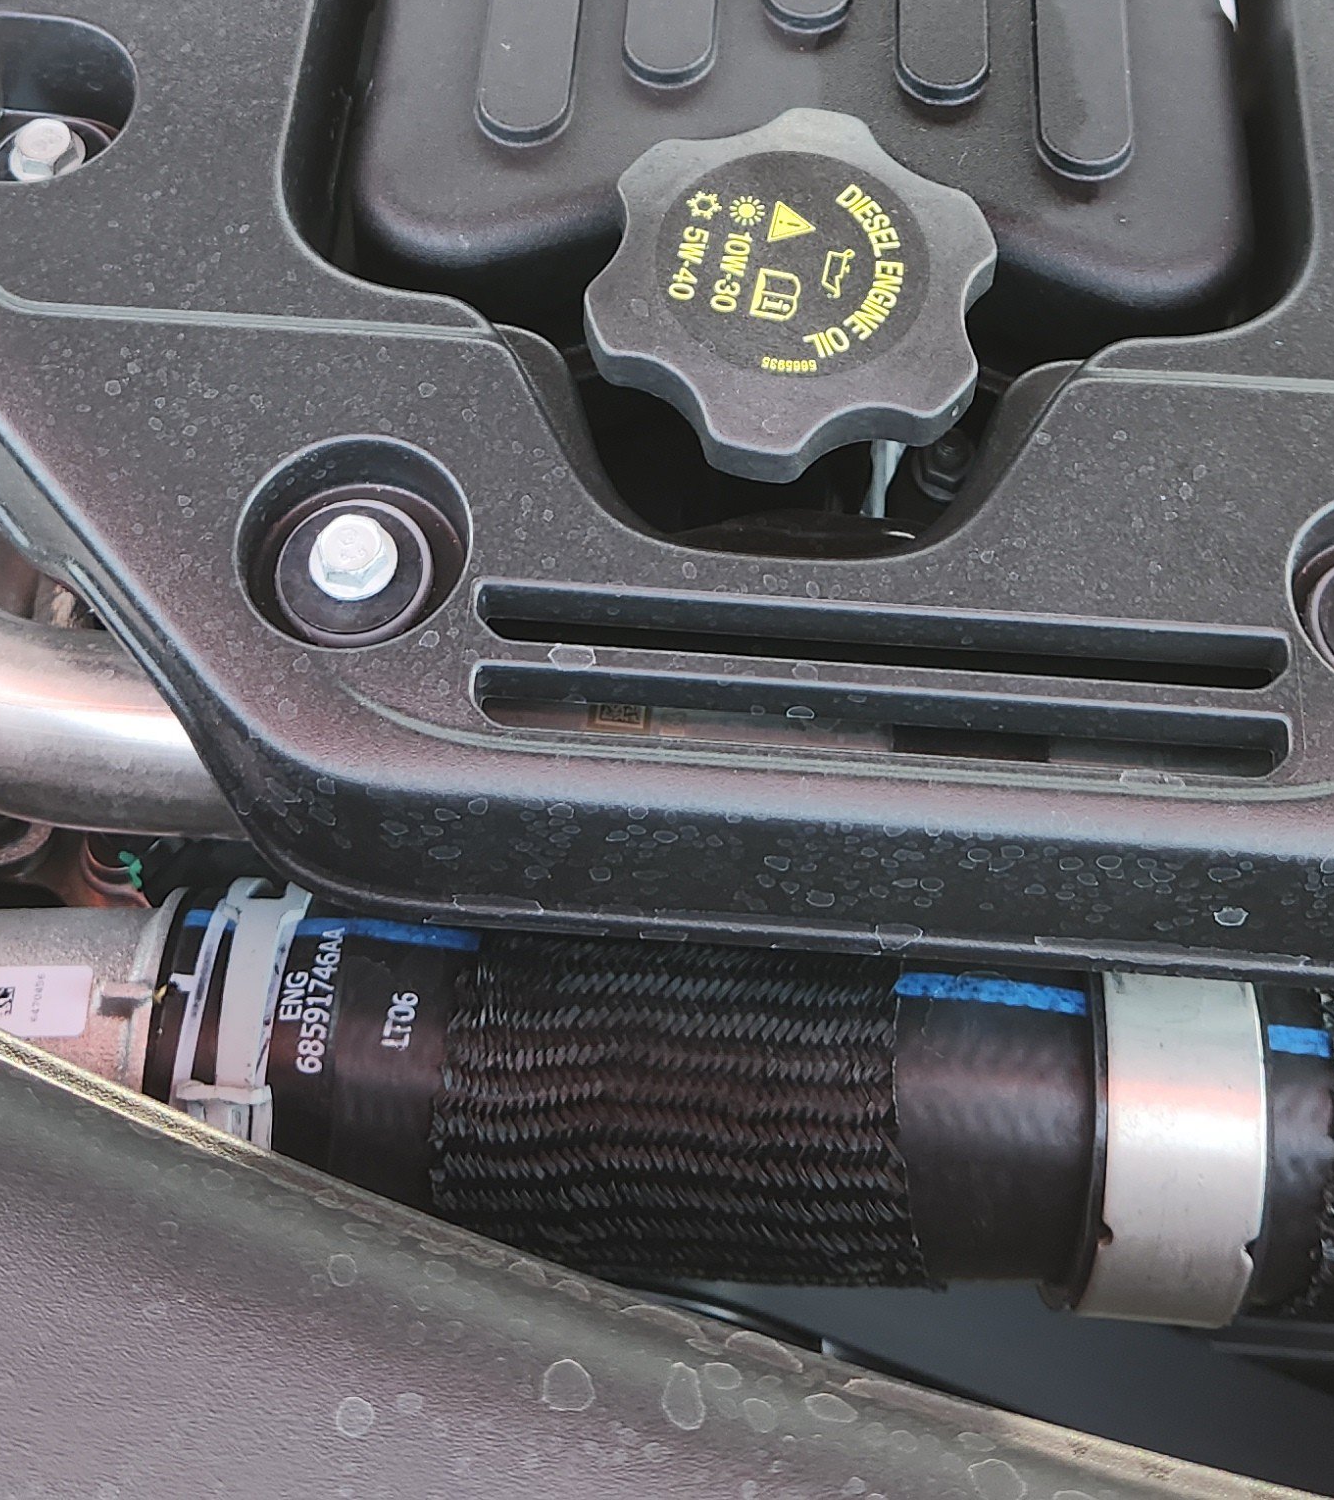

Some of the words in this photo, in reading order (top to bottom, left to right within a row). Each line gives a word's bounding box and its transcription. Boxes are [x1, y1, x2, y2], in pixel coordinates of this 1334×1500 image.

[835, 183, 902, 258] DIESEL
[668, 226, 710, 300] 5W-40
[709, 231, 753, 312] 10W-30
[843, 260, 904, 341] ENGINE
[802, 326, 850, 358] OIL
[279, 971, 309, 1021] ENG
[296, 927, 345, 1074] 68591746AA
